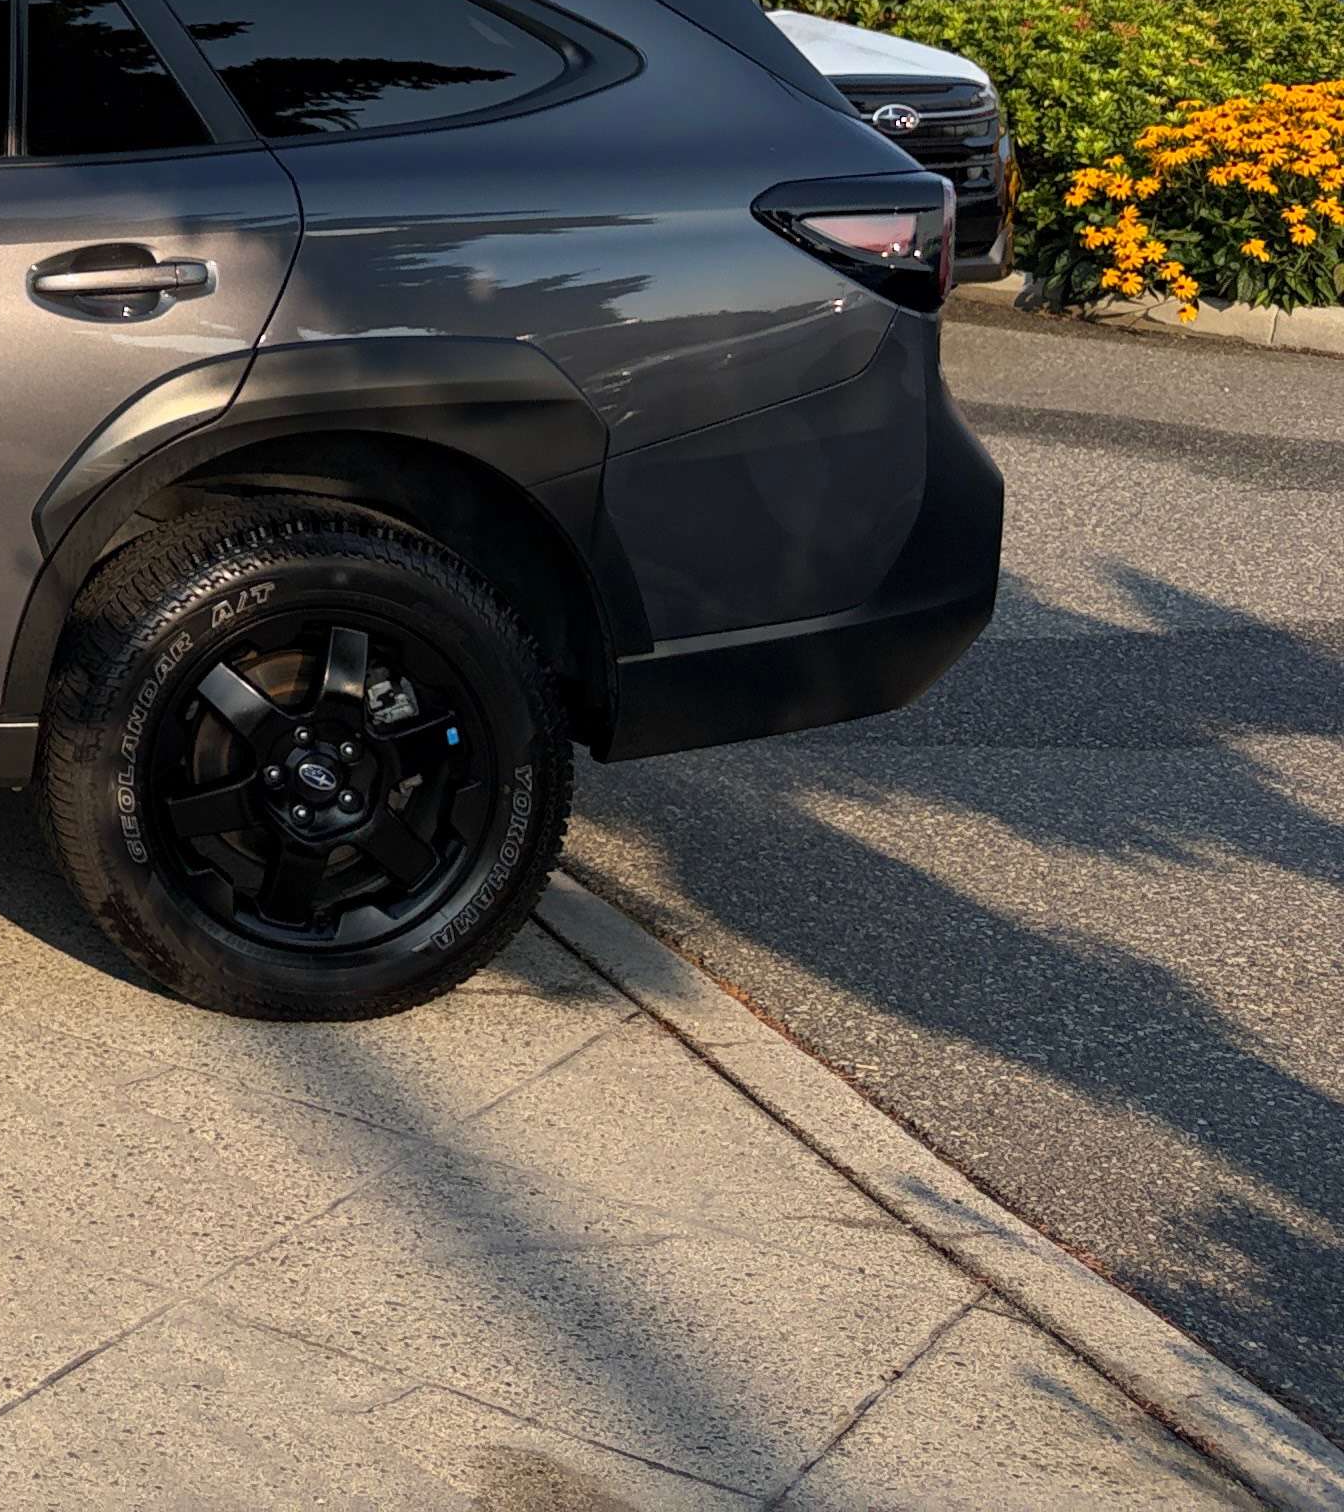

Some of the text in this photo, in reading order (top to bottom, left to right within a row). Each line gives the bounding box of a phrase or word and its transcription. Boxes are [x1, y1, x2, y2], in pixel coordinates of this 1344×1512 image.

[117, 582, 275, 864] GEOLANDAR A/T
[431, 764, 533, 951] YOKOHAMA
